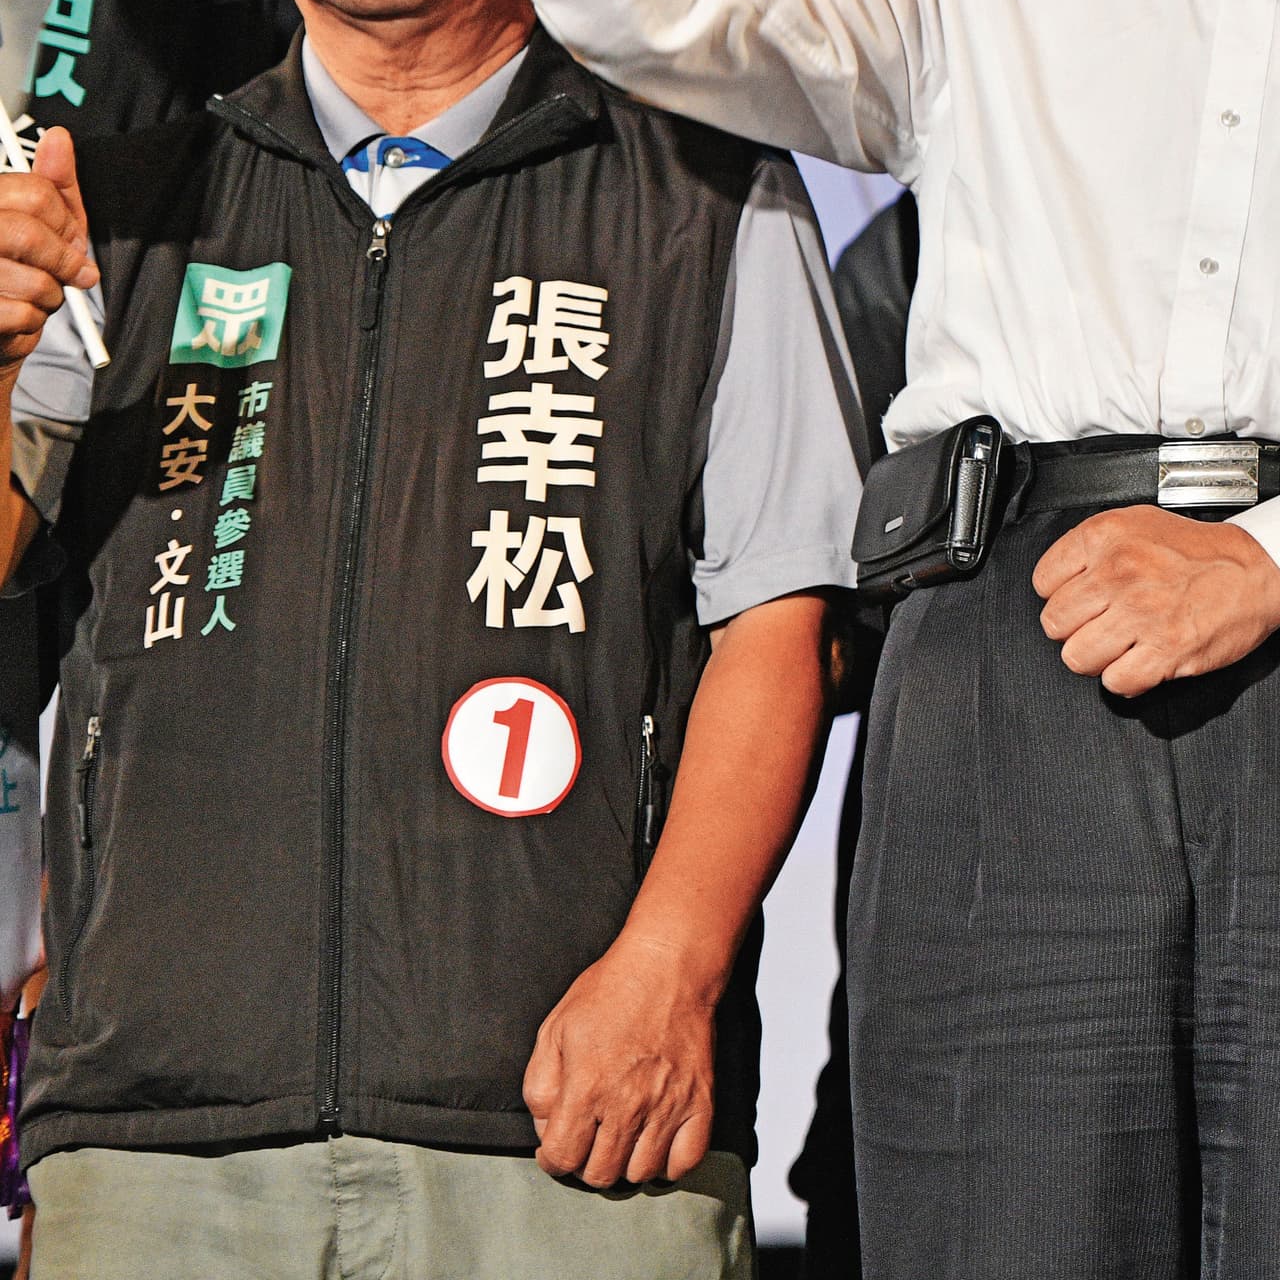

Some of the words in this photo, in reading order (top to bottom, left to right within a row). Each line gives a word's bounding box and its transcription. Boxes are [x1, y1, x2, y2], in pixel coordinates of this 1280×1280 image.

[190, 277, 271, 357] 眾
[200, 380, 274, 637] 市議員參選人
[465, 275, 611, 634] 張幸松
[492, 696, 535, 800] 1
